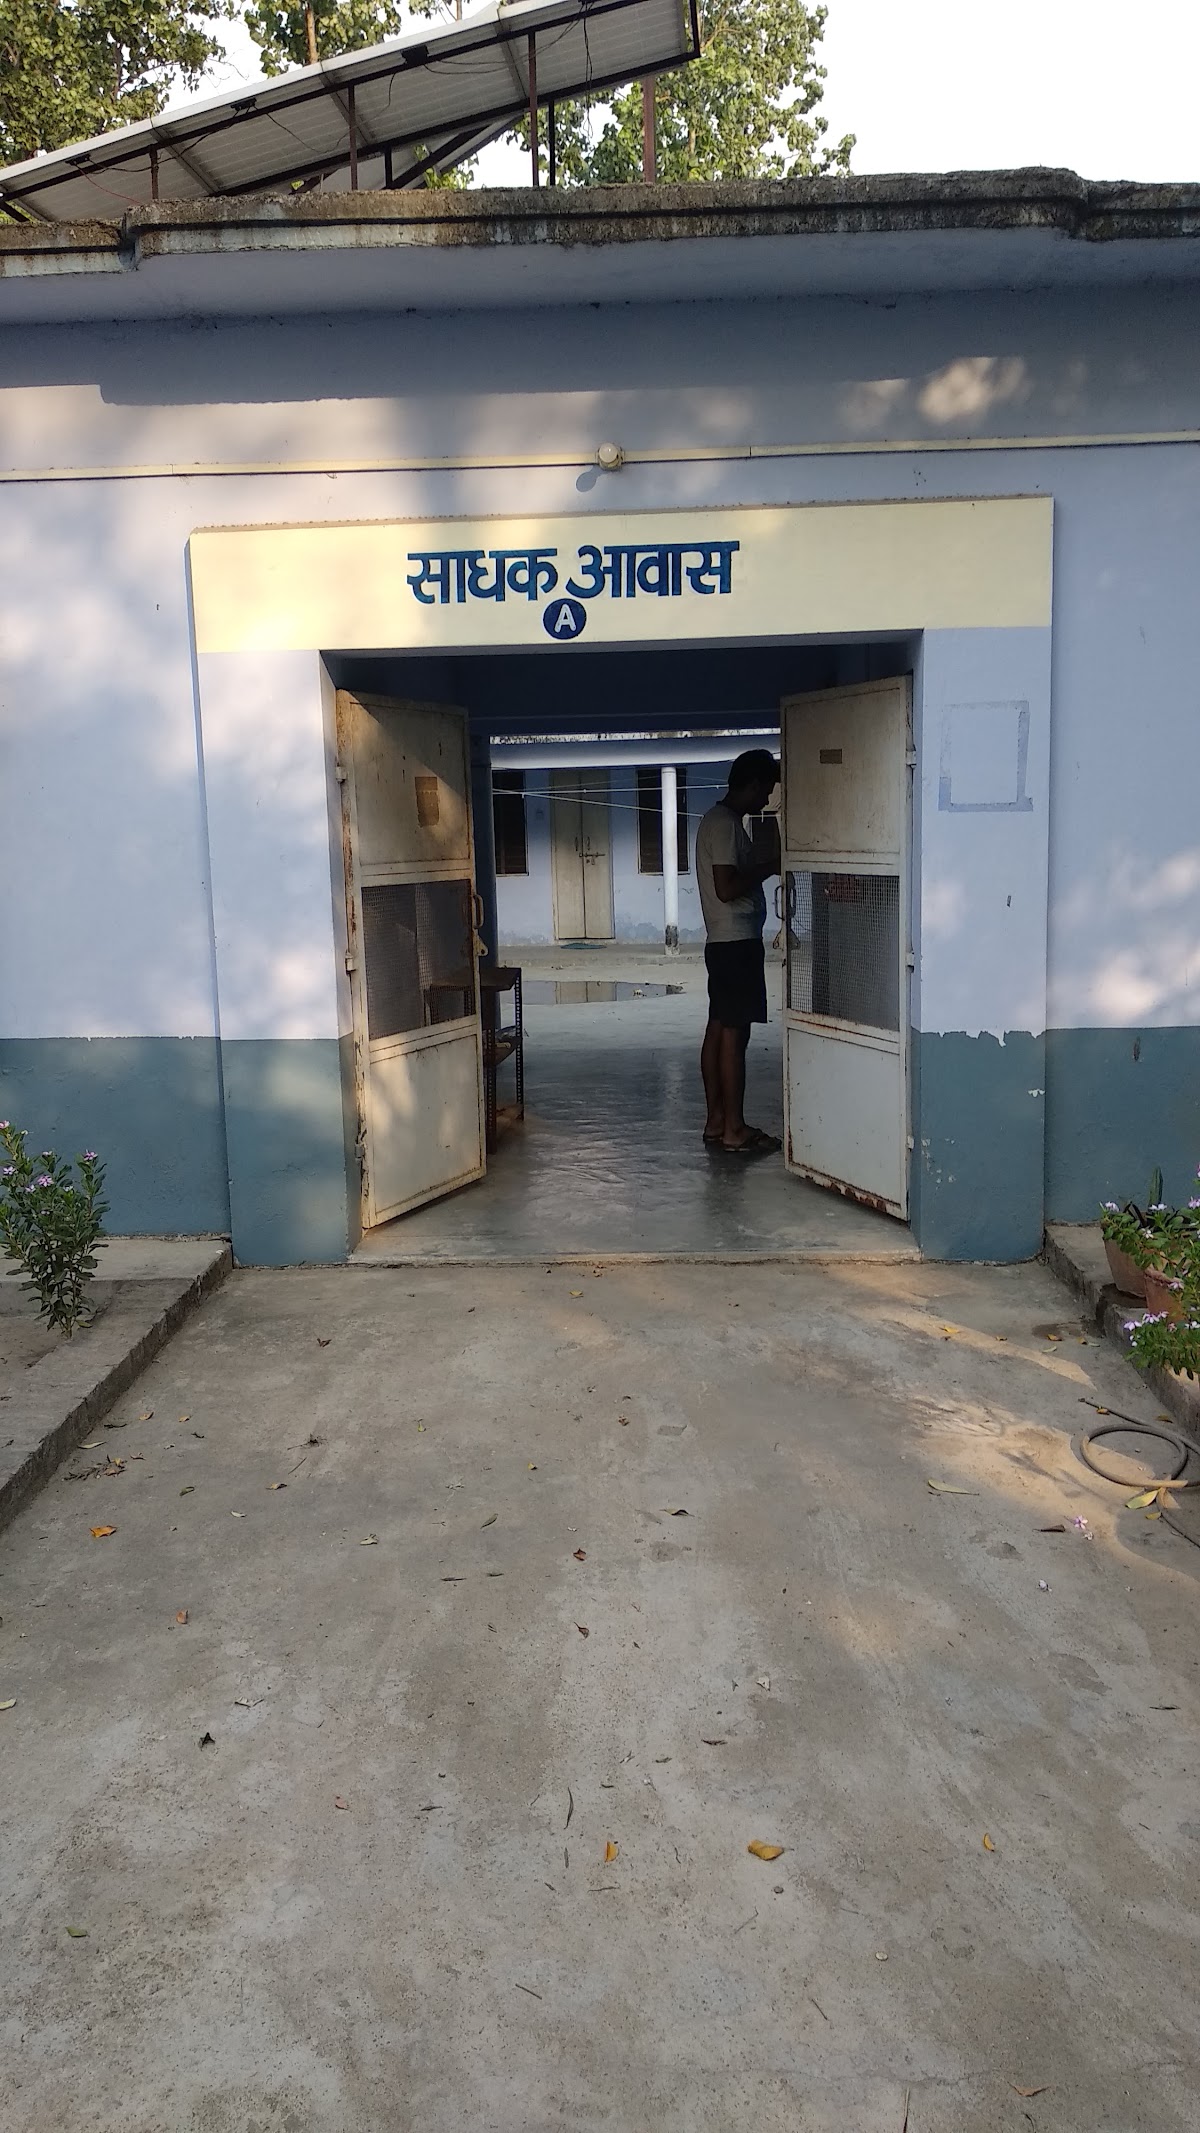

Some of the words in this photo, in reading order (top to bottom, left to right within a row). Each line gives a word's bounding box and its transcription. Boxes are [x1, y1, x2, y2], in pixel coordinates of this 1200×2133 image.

[407, 548, 558, 604] साधक
[565, 541, 740, 599] आवास
[554, 602, 577, 633] A
